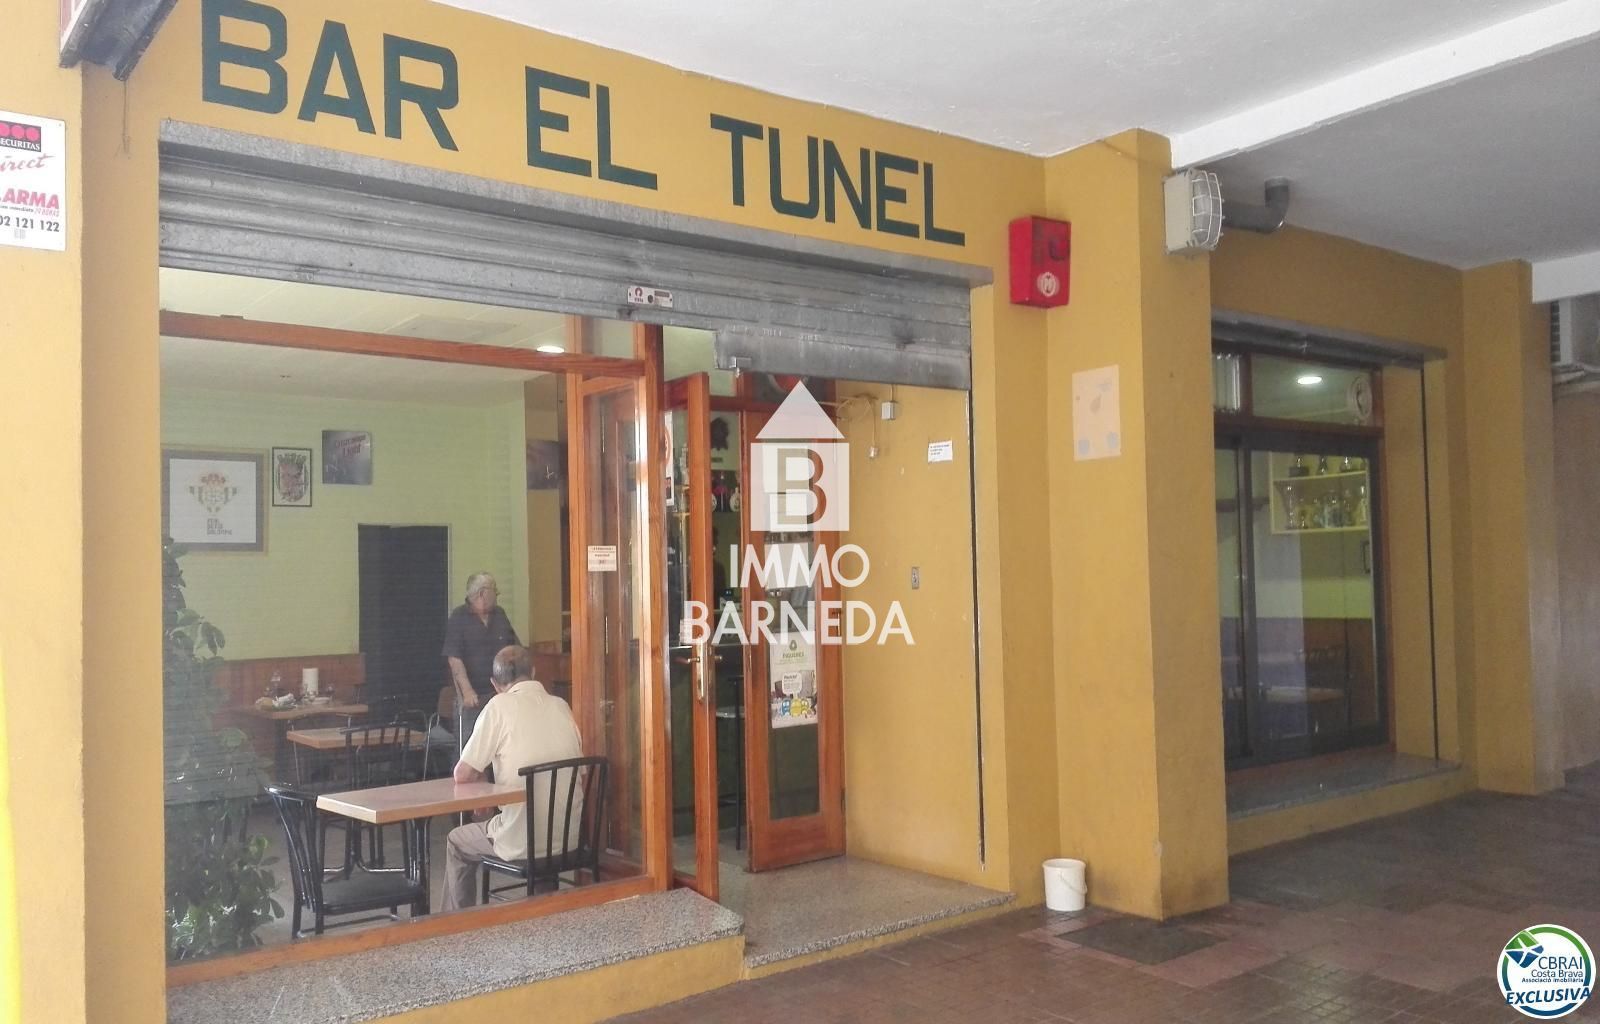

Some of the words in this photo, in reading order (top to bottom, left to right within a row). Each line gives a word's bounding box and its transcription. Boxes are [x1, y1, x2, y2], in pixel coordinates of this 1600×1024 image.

[201, 0, 459, 152] BAR
[525, 65, 658, 191] EL
[710, 112, 966, 247] TUNEL
[15, 217, 34, 229] 121
[40, 220, 60, 232] 122
